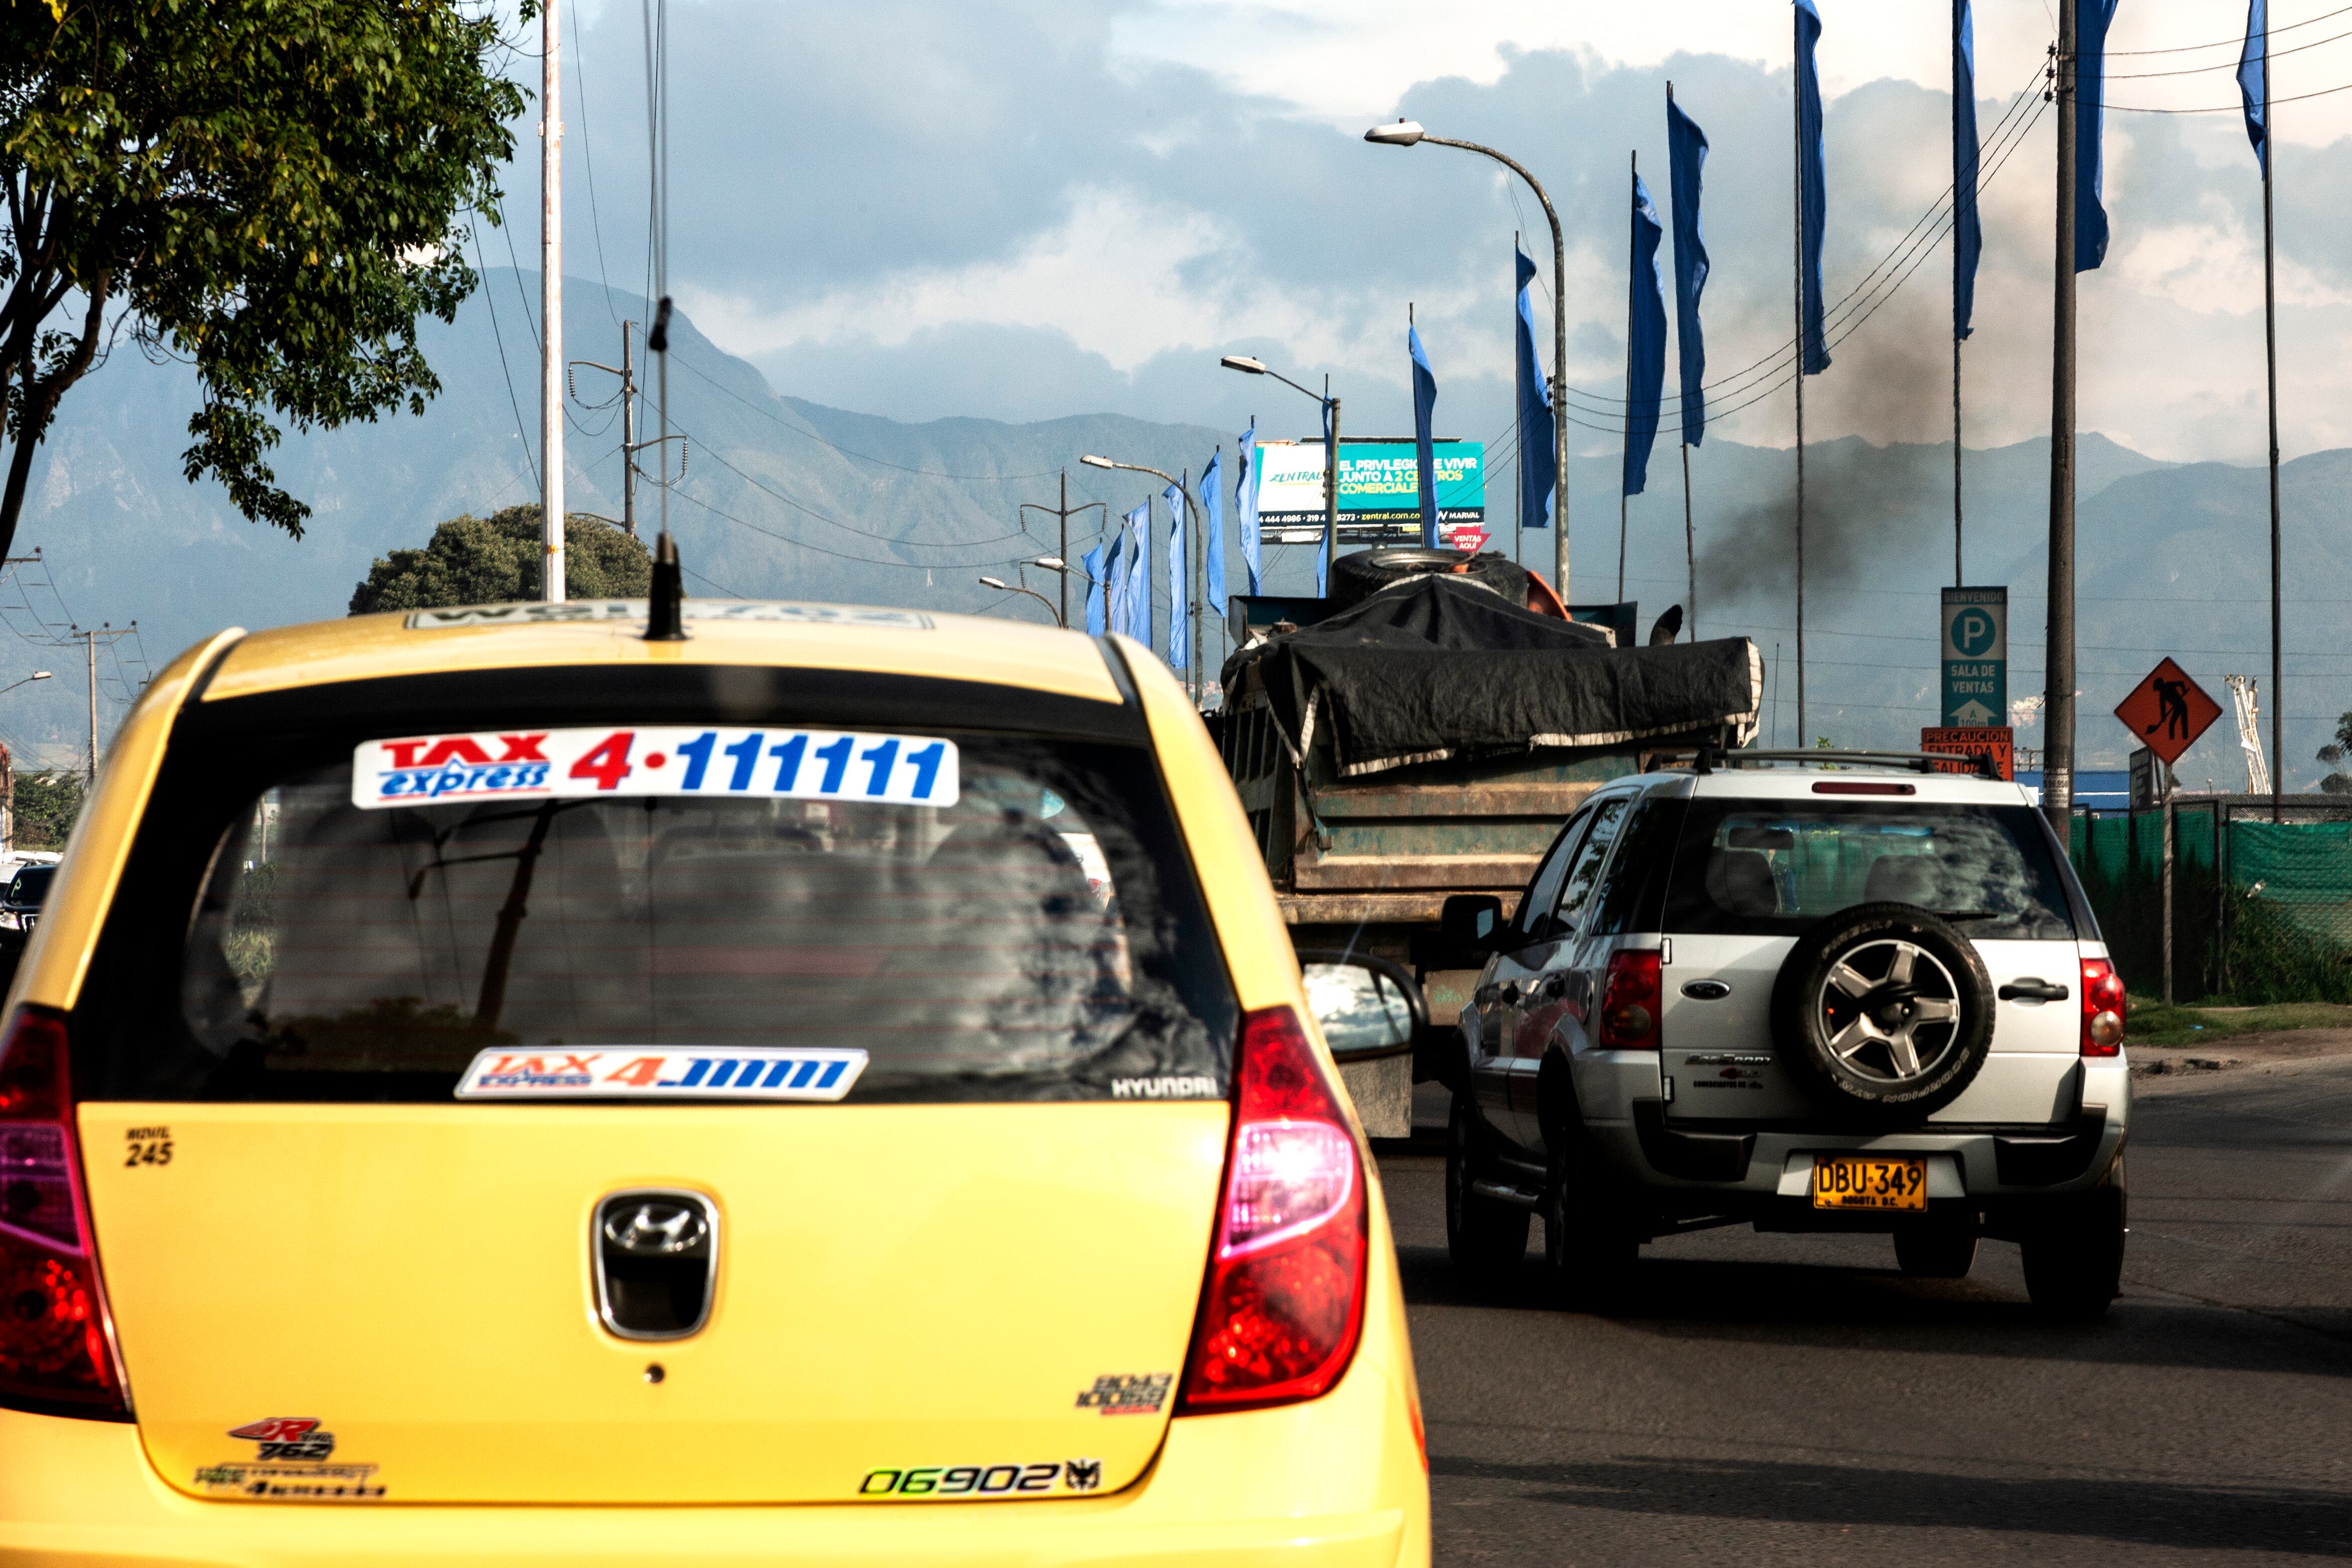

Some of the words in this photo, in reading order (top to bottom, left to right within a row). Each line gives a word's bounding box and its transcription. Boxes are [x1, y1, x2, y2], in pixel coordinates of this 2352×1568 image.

[1340, 460, 1354, 471] EL
[1444, 458, 1477, 469] VIVIR
[1269, 471, 1322, 483] ZENTRAL
[1339, 471, 1381, 483] JUNTO
[1383, 471, 1393, 482] A
[1394, 471, 1403, 482] 2
[1404, 470, 1463, 482] CETROS
[1265, 515, 1280, 523] 444
[1281, 514, 1301, 522] 4986
[1361, 512, 1420, 521] zentral.com.co
[1455, 535, 1482, 543] VENTAS
[1964, 616, 1986, 649] P
[1951, 664, 1978, 677] SALA
[1981, 664, 1995, 677] DE
[1952, 681, 1994, 694] VENTAS
[1969, 709, 1977, 718] A
[1998, 744, 2007, 758] Y
[380, 761, 551, 797] express
[1111, 1076, 1219, 1099] HYUNDAI
[126, 1140, 173, 1167] 245
[258, 1442, 330, 1460] 762
[858, 1464, 1062, 1495] 06902
